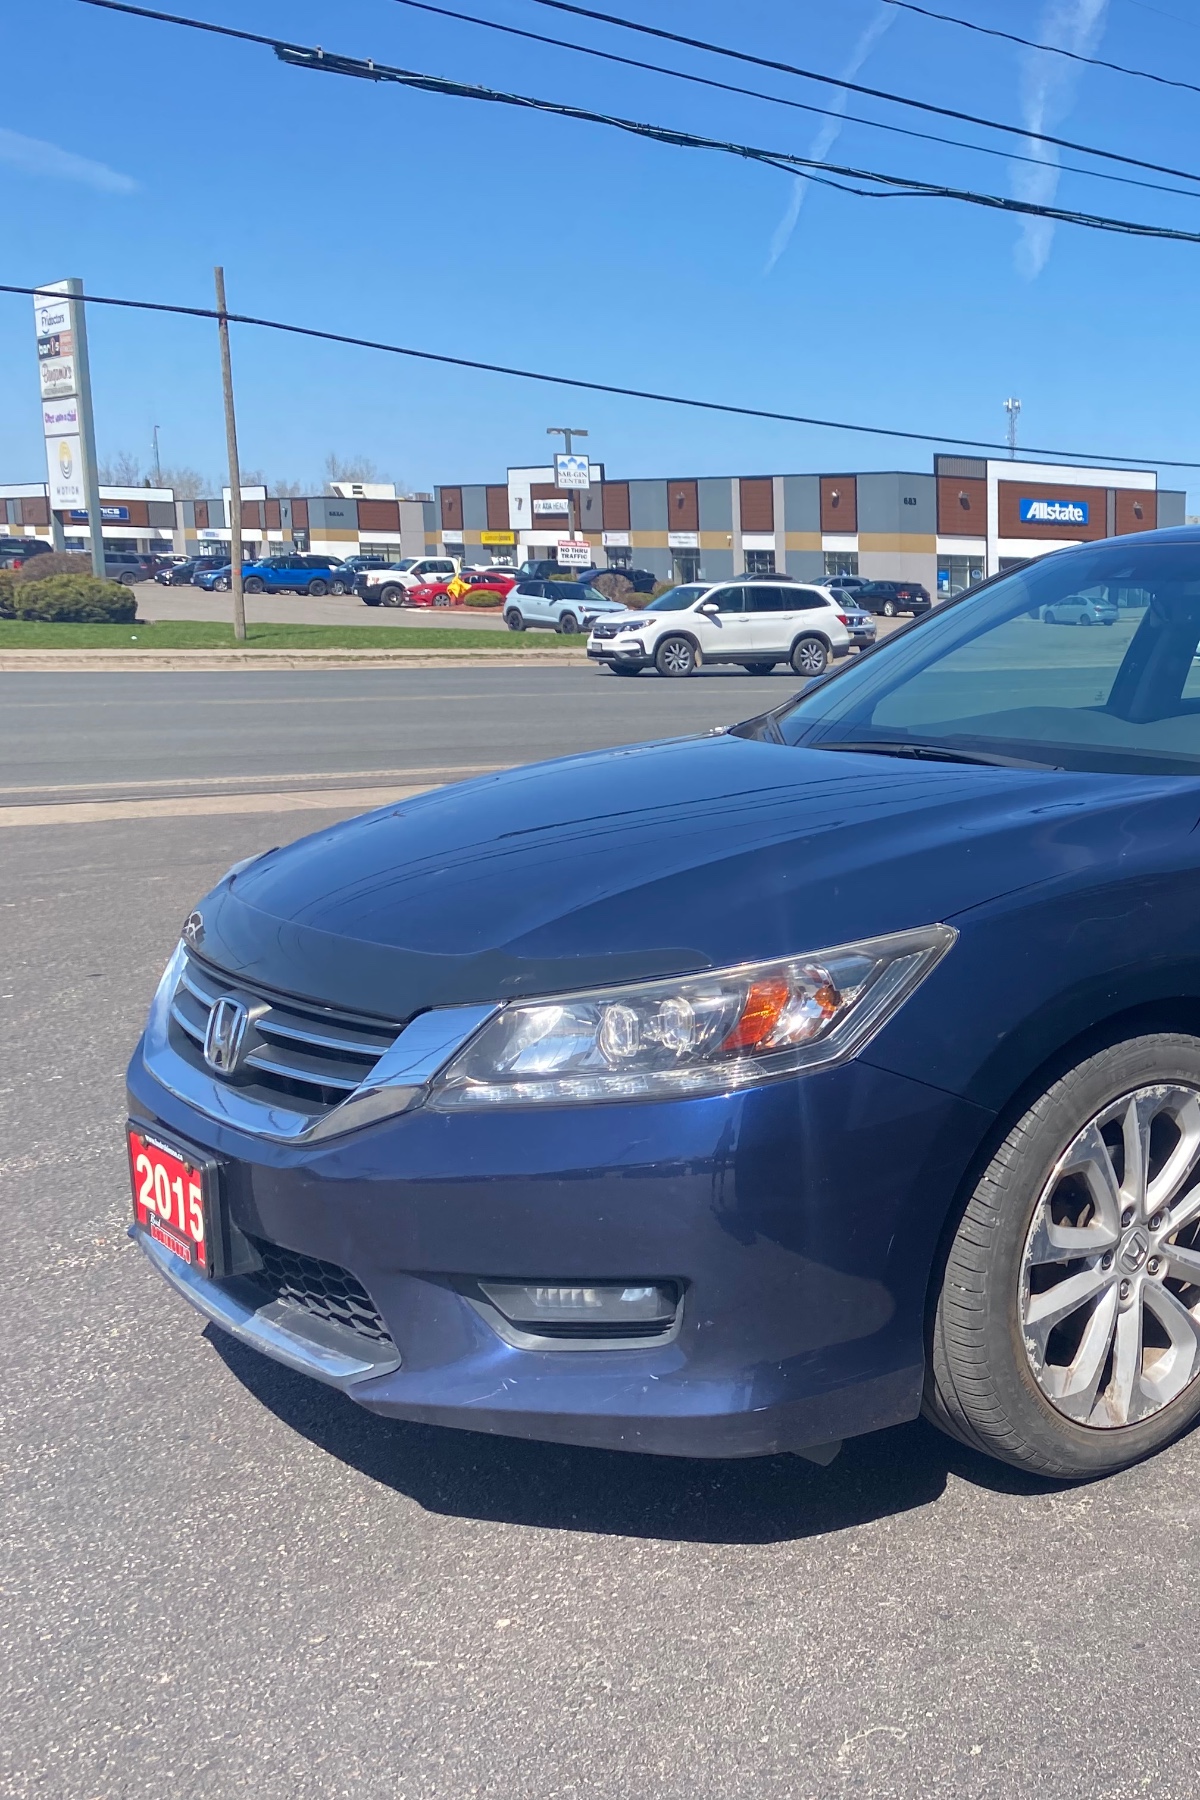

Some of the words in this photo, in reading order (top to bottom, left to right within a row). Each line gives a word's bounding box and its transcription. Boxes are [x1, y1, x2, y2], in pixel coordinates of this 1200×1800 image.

[558, 471, 588, 479] SAR-GIN
[57, 486, 79, 495] MOTION
[553, 501, 568, 510] HEALT
[1027, 502, 1083, 522] Allstate
[136, 1153, 204, 1243] 2015
